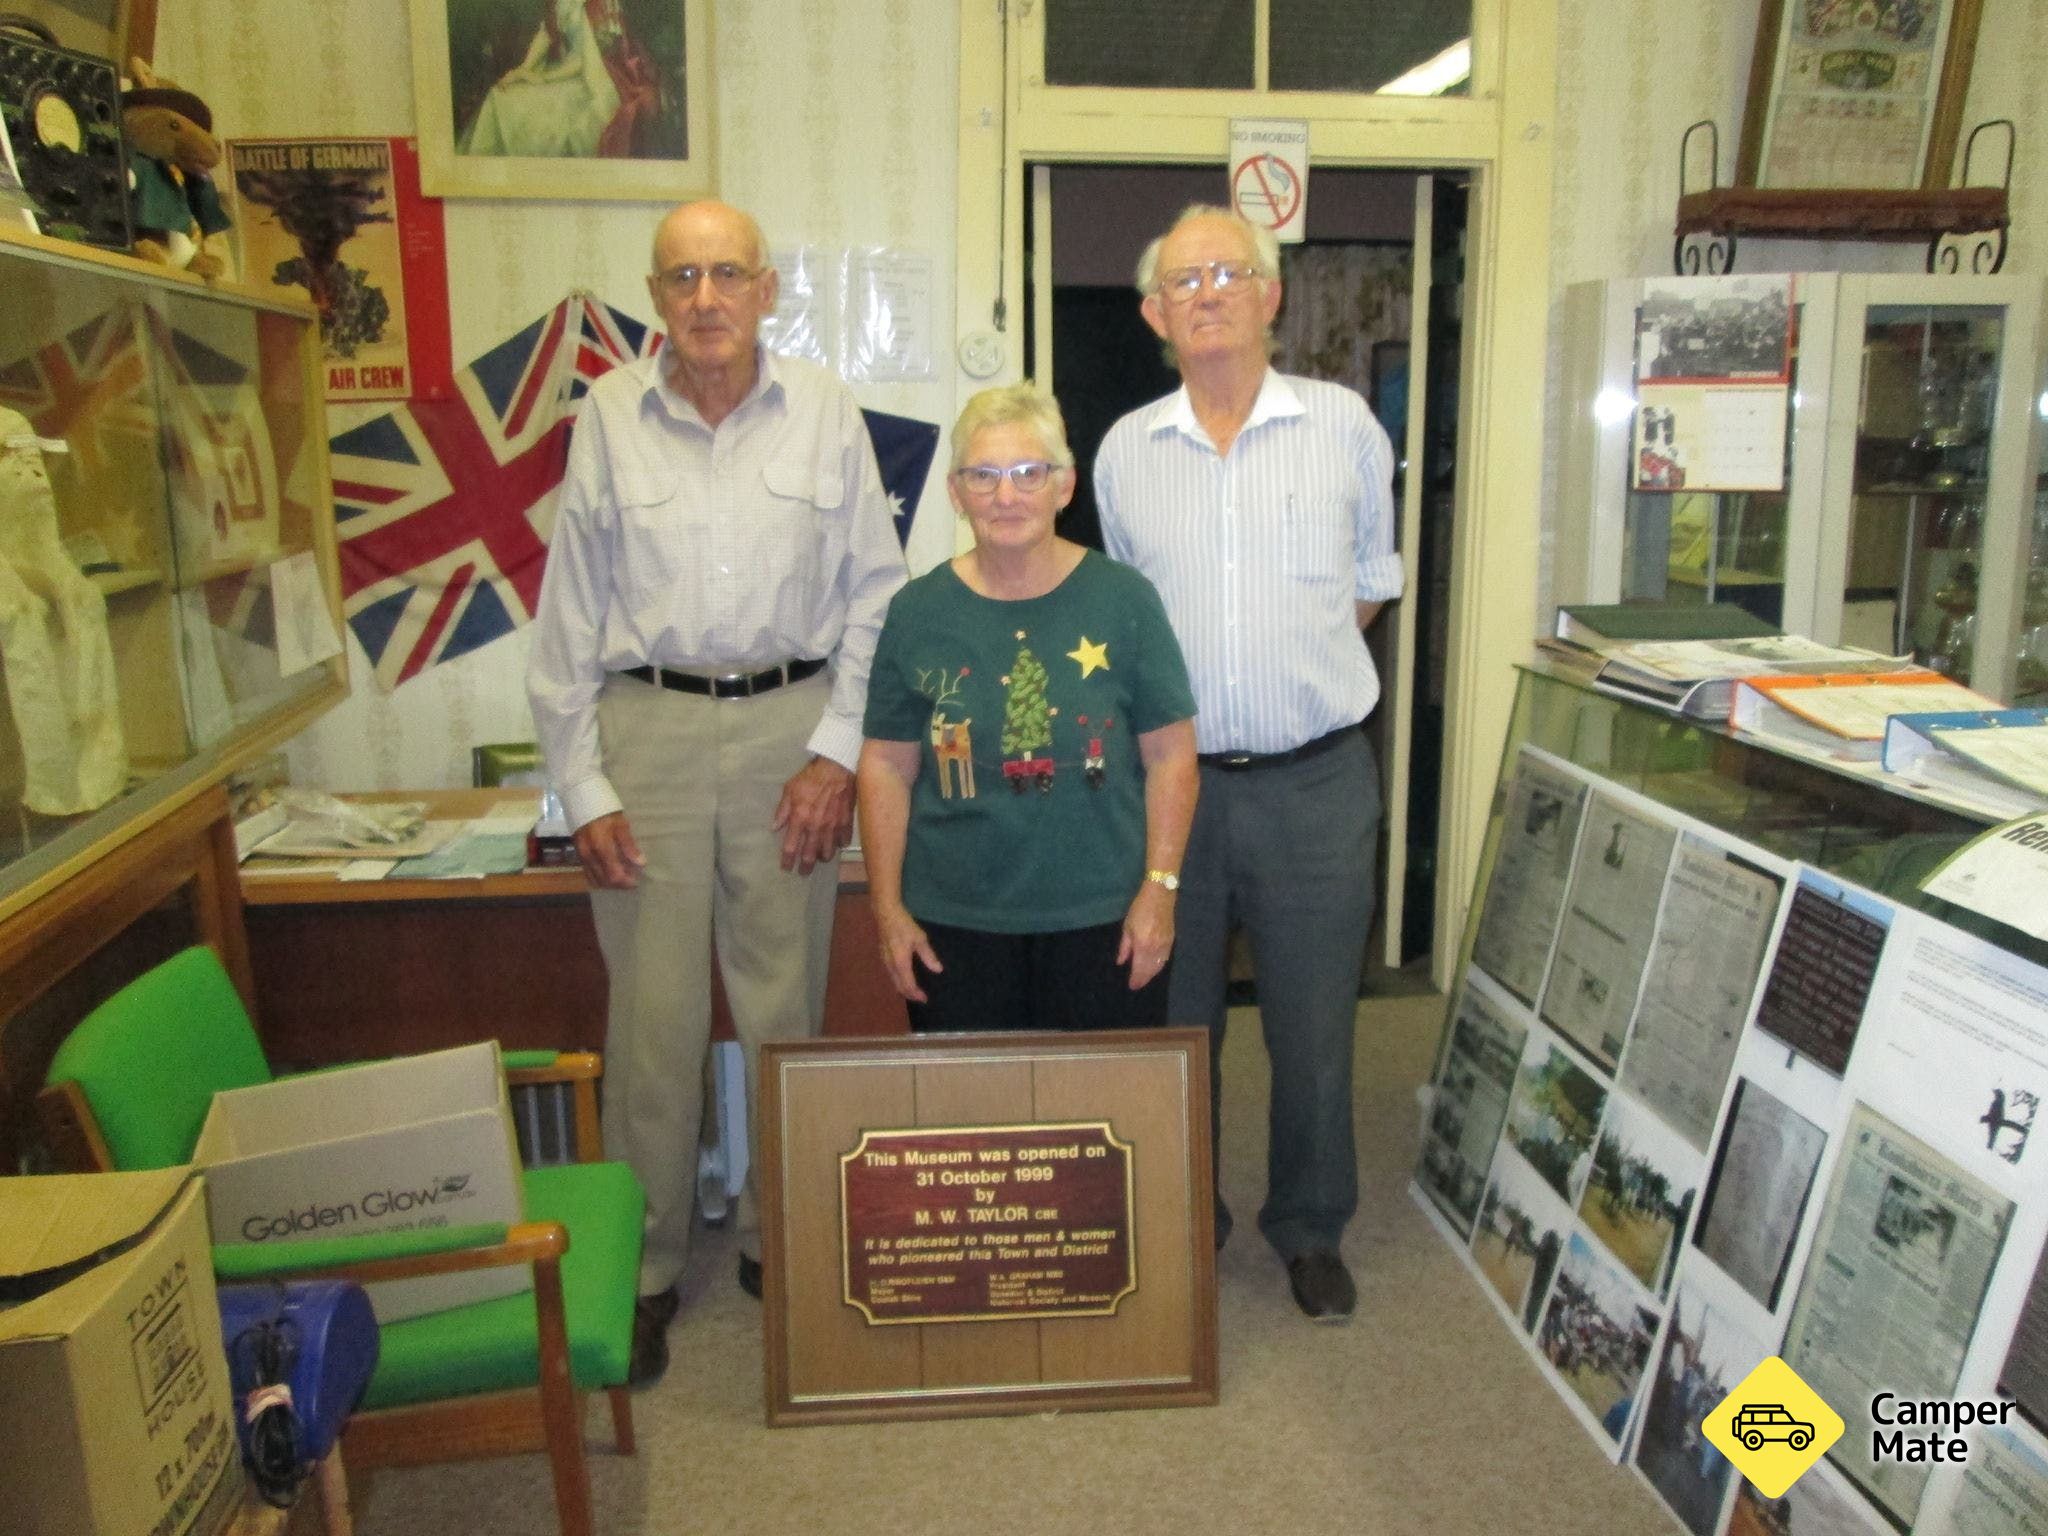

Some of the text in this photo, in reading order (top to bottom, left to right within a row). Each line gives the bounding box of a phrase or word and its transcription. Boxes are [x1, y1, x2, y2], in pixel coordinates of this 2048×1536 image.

[1231, 131, 1306, 143] NO SMOKING
[235, 145, 389, 171] BATTLE OF GERMANY
[328, 366, 404, 390] AIR CREW
[865, 1145, 1106, 1167] This Museum was opened on
[916, 1166, 1053, 1186] 31 October 1999
[975, 1187, 996, 1204] by
[242, 1204, 357, 1242] Golden
[361, 1187, 438, 1217] Glow
[915, 1210, 933, 1225] M.
[941, 1209, 960, 1224] W.
[967, 1207, 1028, 1223] TAYLOR
[865, 1230, 1116, 1250] It is dedicated to those men & women
[868, 1242, 1108, 1266] who pioneered this Town and District
